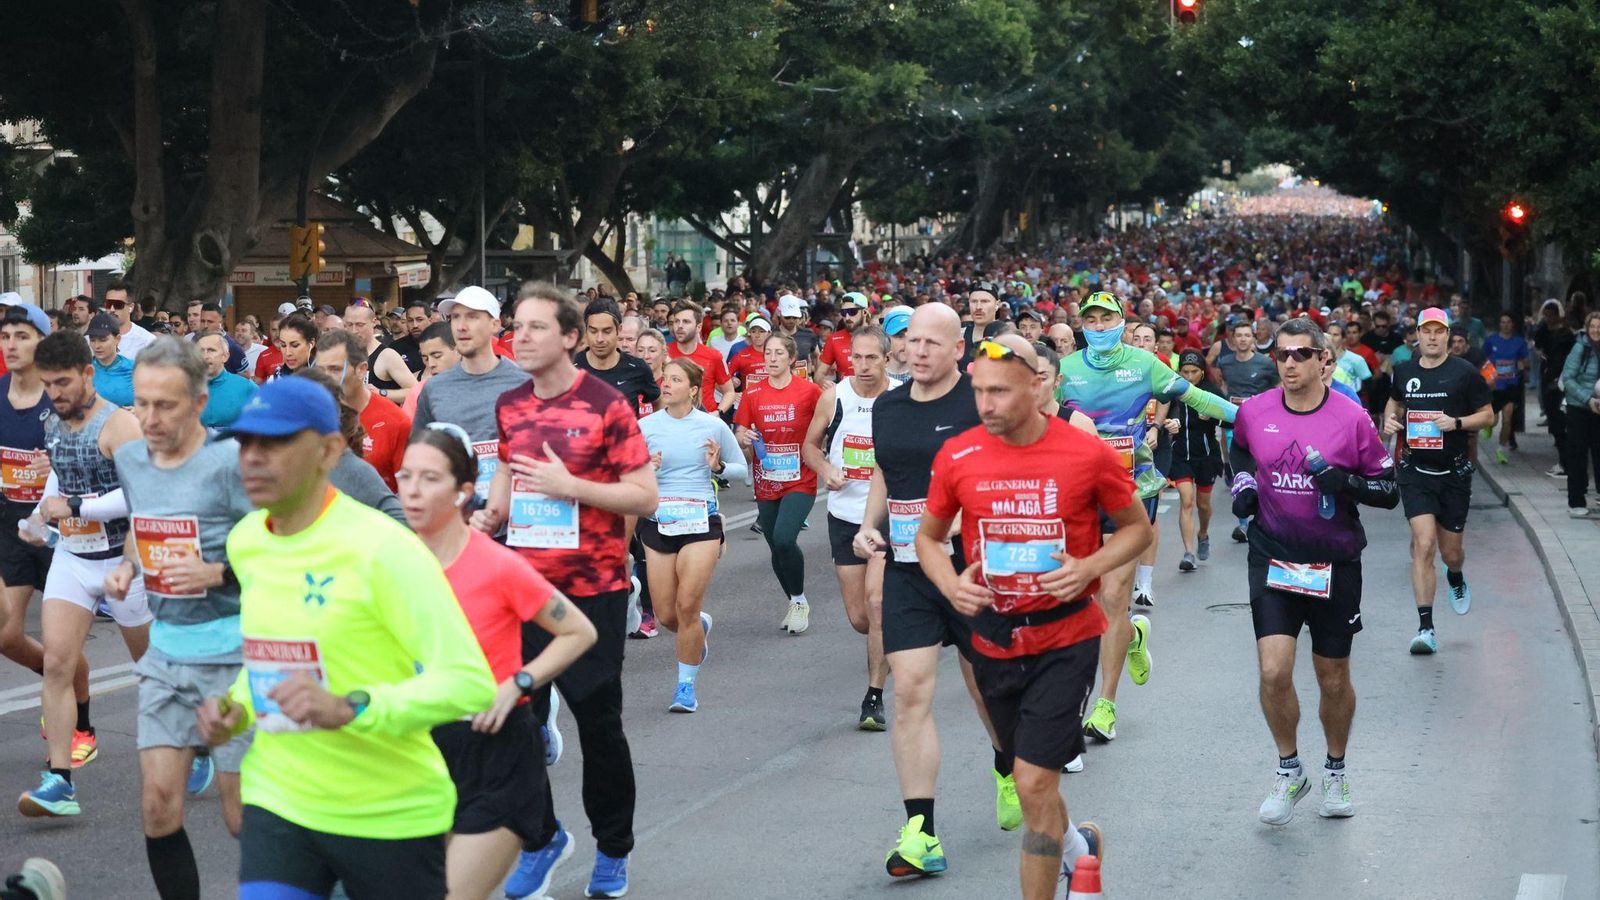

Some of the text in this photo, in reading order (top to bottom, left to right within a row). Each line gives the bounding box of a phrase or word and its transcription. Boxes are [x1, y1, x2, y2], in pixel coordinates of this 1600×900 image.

[12, 468, 37, 480] 2259
[1272, 472, 1314, 489] DARK
[991, 480, 1040, 491] GENERALI
[522, 502, 561, 517] 16796
[992, 498, 1041, 515] MÁLAGA
[1002, 524, 1058, 536] GENERALI
[1009, 547, 1038, 562] 725
